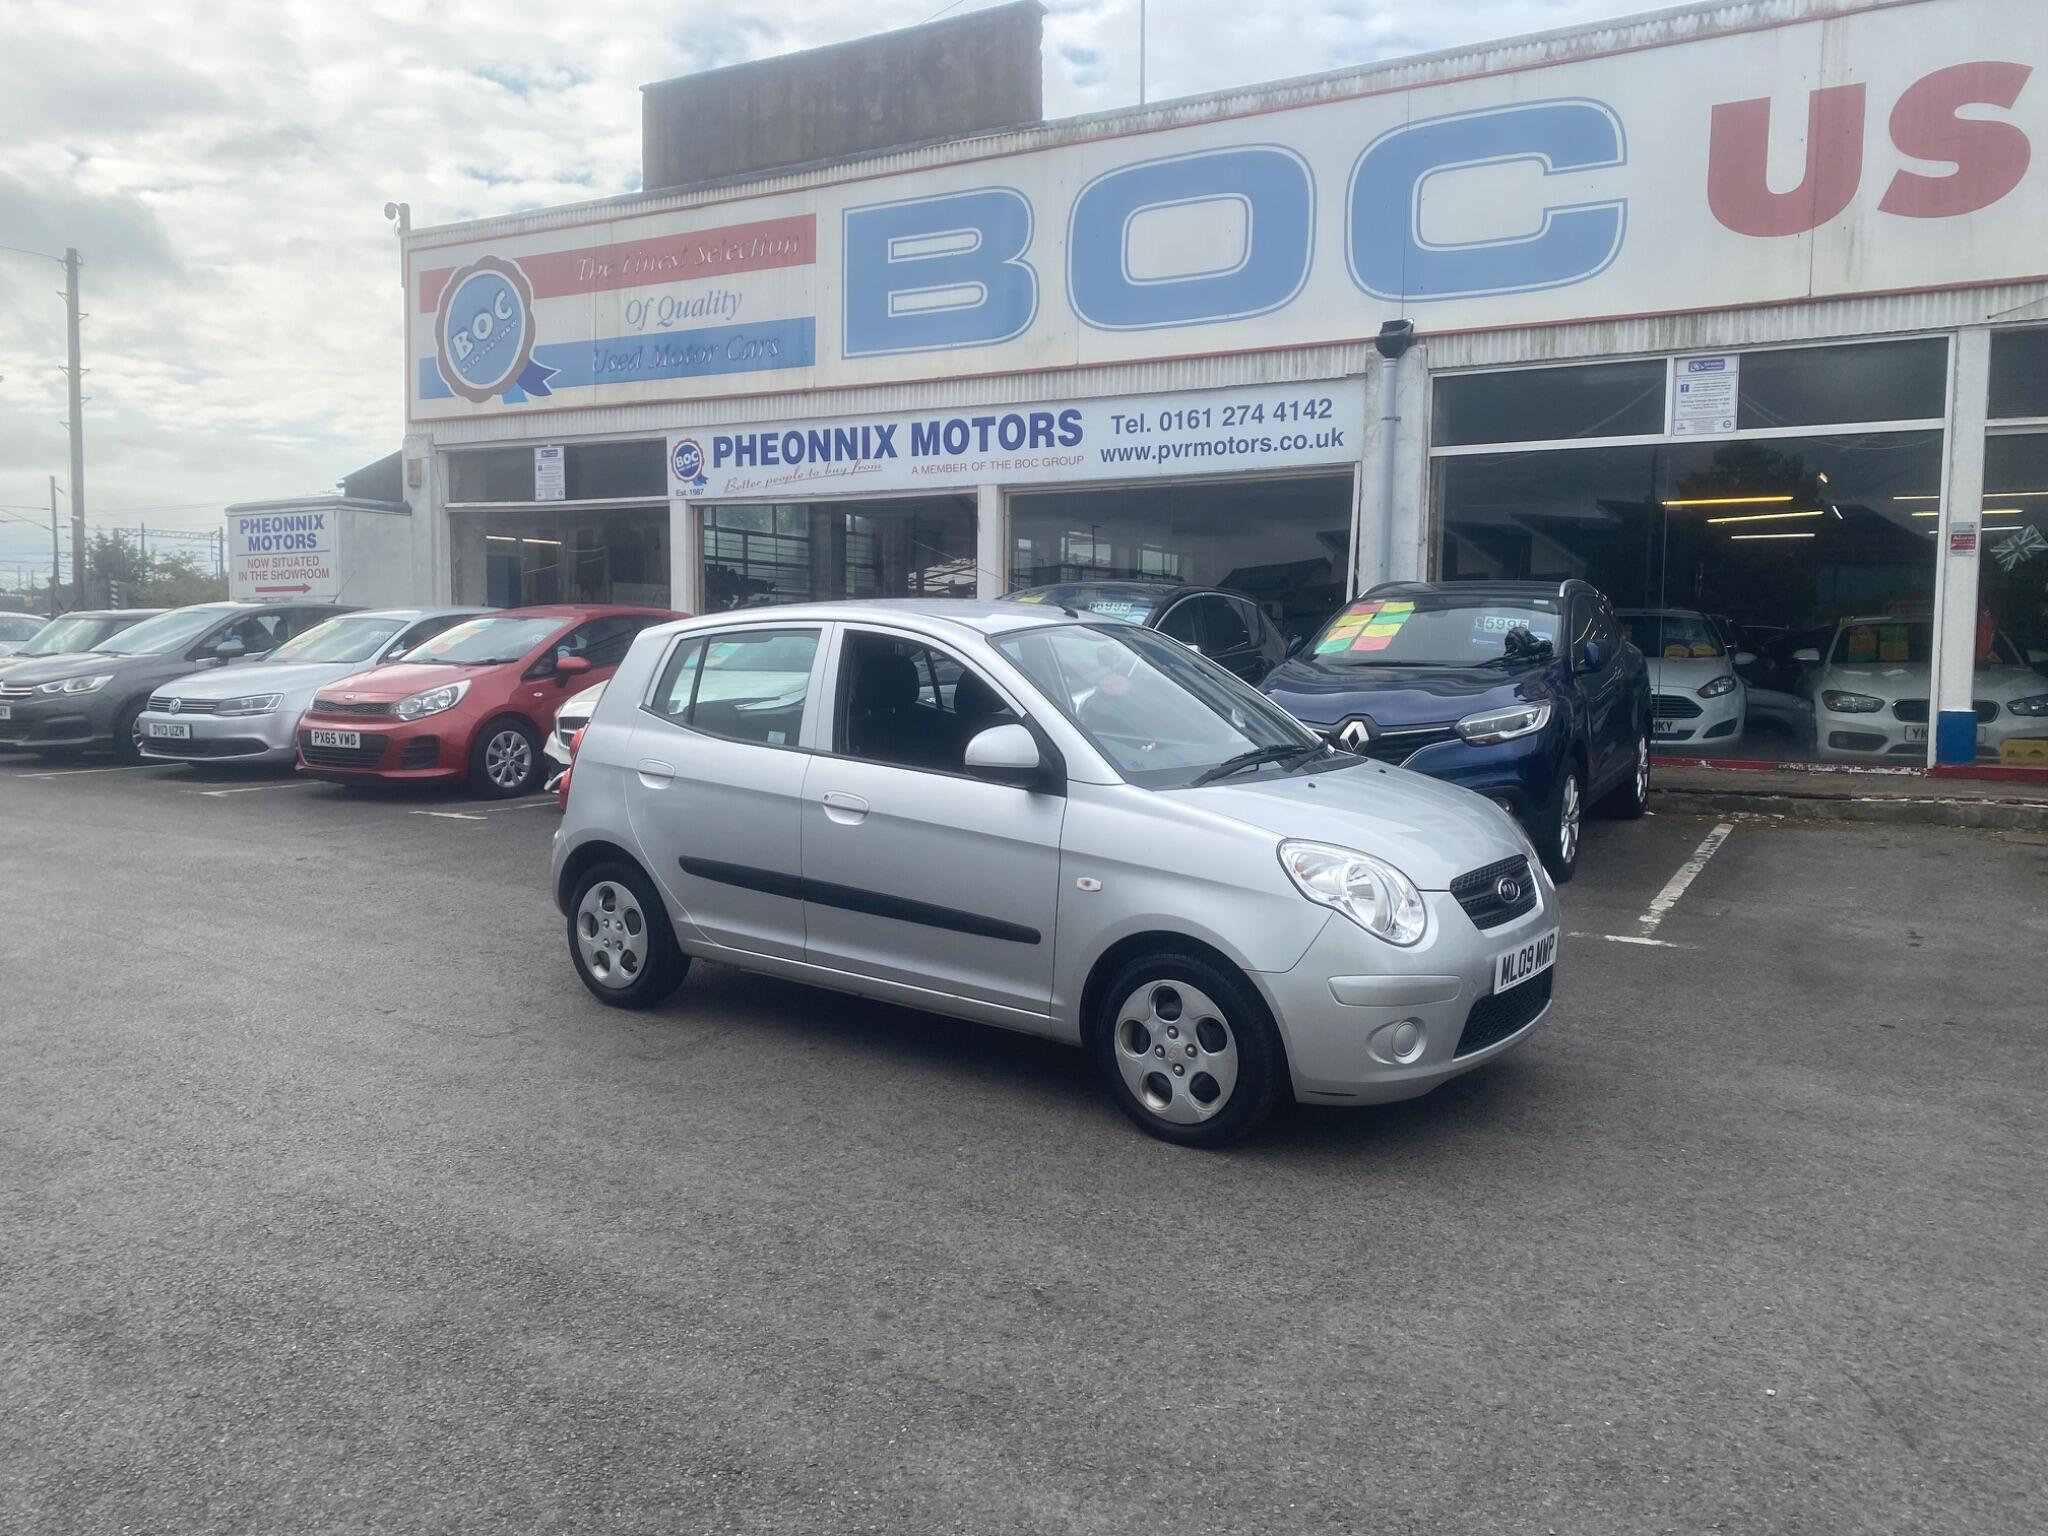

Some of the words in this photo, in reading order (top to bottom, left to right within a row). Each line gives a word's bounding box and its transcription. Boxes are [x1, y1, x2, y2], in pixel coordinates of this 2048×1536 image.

[842, 97, 1627, 359] BOC
[578, 257, 614, 281] The
[622, 246, 688, 275] Finest
[694, 233, 799, 266] Selection
[452, 289, 513, 361] BOC
[626, 297, 653, 331] Of
[656, 289, 743, 327] Quality
[592, 345, 642, 374] Used
[648, 342, 720, 369] Motor
[726, 334, 781, 362] Cars
[1110, 413, 1151, 435] Tel.
[1159, 407, 1212, 432] 0161
[1221, 403, 1265, 427] 274
[1272, 397, 1333, 422] 4142
[713, 423, 899, 468] PHEONNIX
[910, 408, 1084, 457] MOTORS
[1100, 427, 1345, 464] www.pvrmotors.co.uk
[676, 450, 699, 468] BOC
[724, 476, 762, 494] Better
[764, 465, 802, 488] people
[808, 467, 820, 477] to
[825, 462, 847, 477] buy
[850, 457, 882, 475] from
[911, 465, 919, 475] A
[921, 462, 967, 475] MEMBER
[971, 461, 987, 472] OF
[990, 459, 1011, 471] THE
[1014, 457, 1039, 469] BOC
[1042, 455, 1085, 467] GROUP
[239, 514, 325, 535] PHEONNIX
[248, 532, 317, 552] MOTORS
[238, 571, 248, 582] IN
[249, 569, 269, 581] THE
[271, 567, 330, 580] SHOWROOM
[247, 557, 270, 570] NOW
[271, 555, 320, 568] SITUATED
[314, 731, 336, 744] PX65
[1500, 944, 1534, 986] ML09
